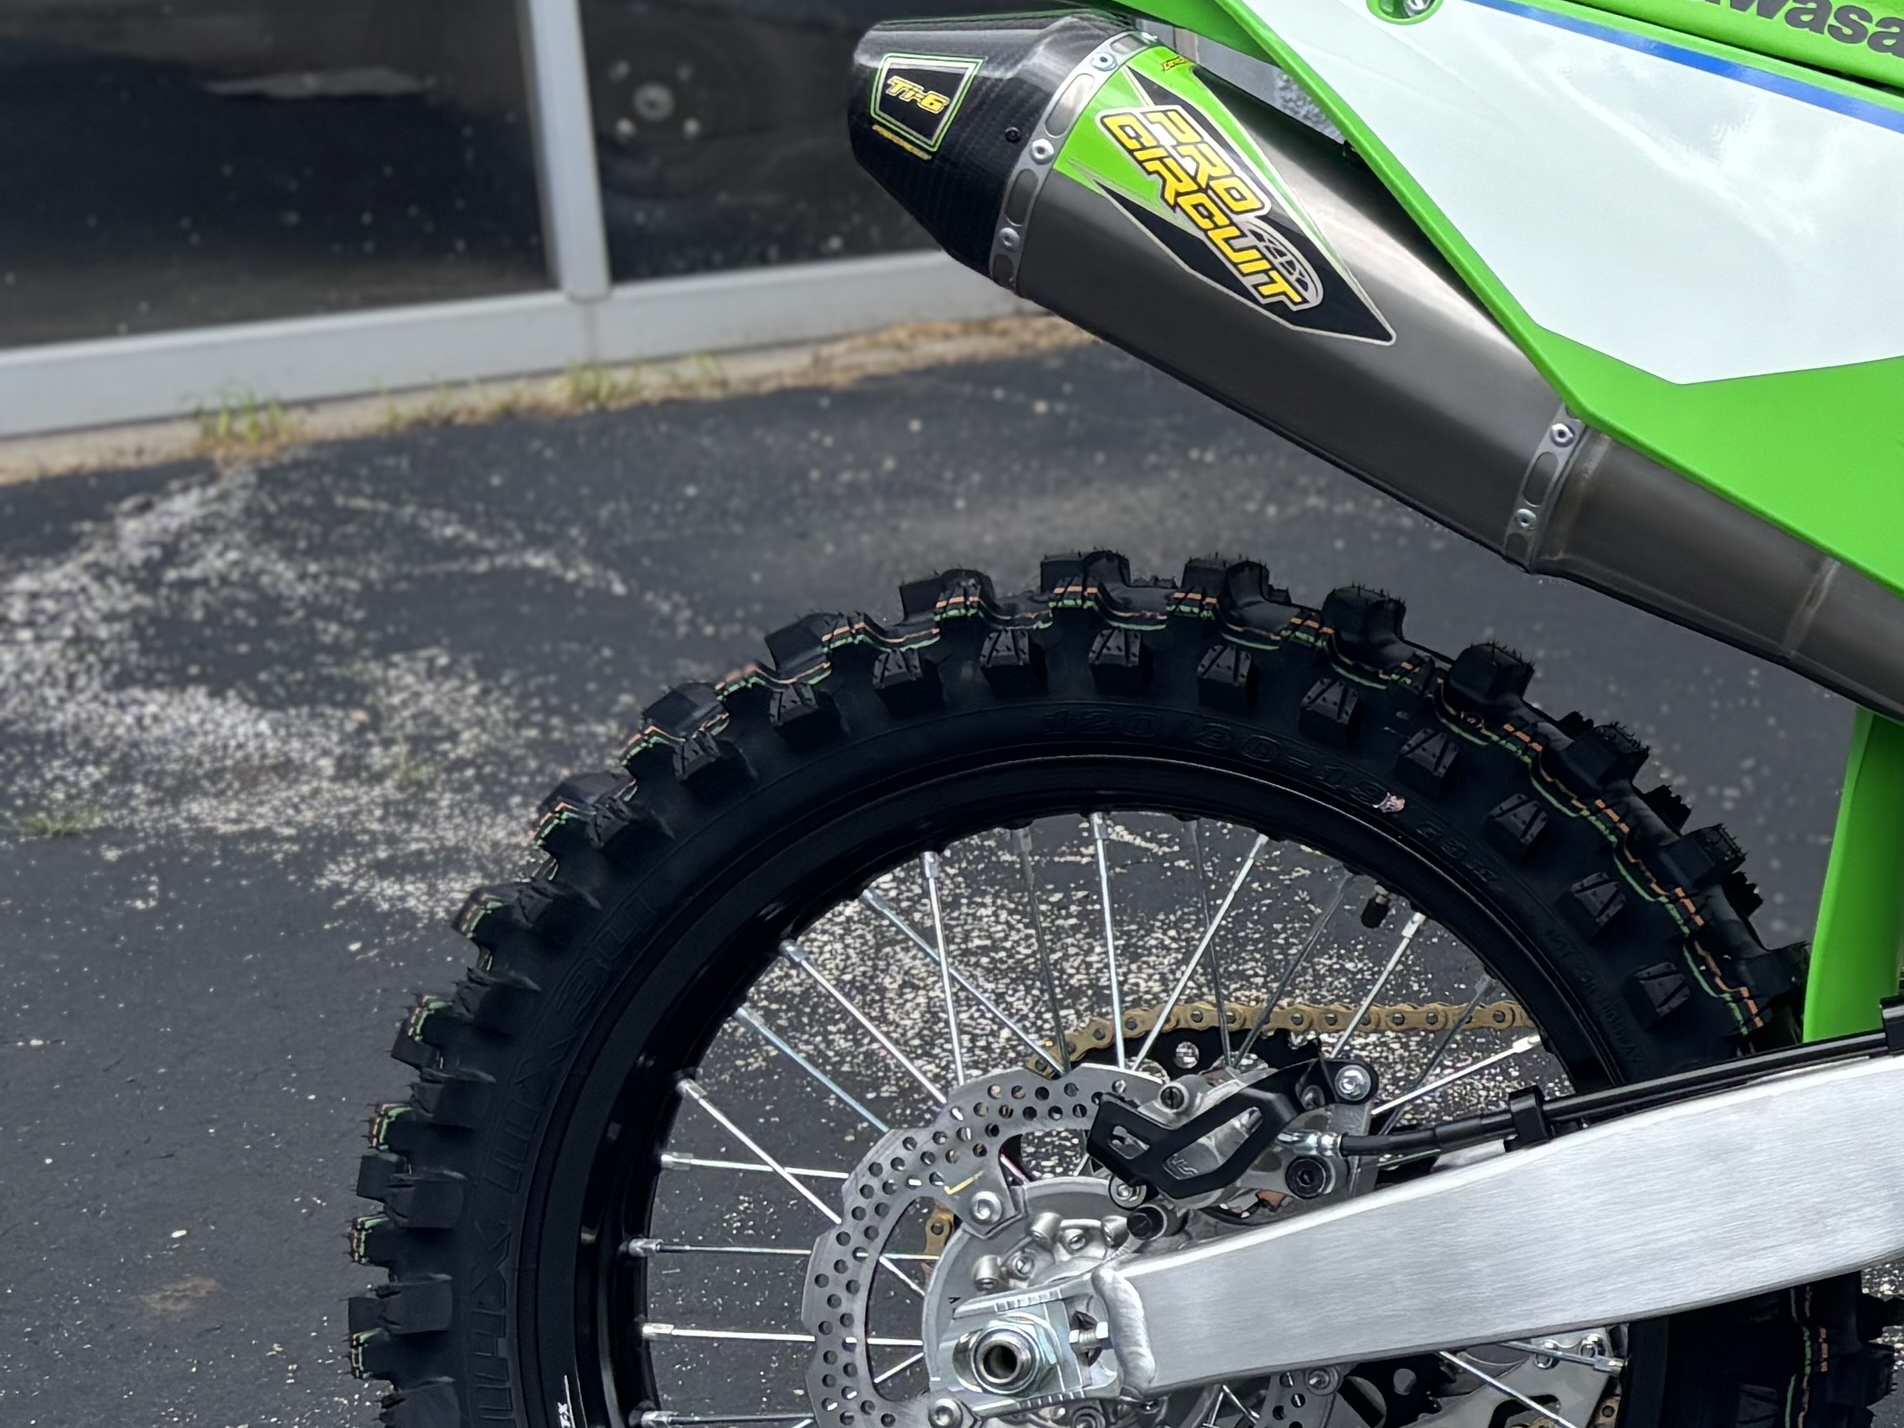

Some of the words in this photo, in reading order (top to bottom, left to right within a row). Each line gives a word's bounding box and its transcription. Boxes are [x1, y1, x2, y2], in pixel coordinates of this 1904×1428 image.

[886, 75, 950, 115] Ti-6
[1100, 112, 1310, 307] CIRCUIT
[1139, 108, 1267, 215] PRO
